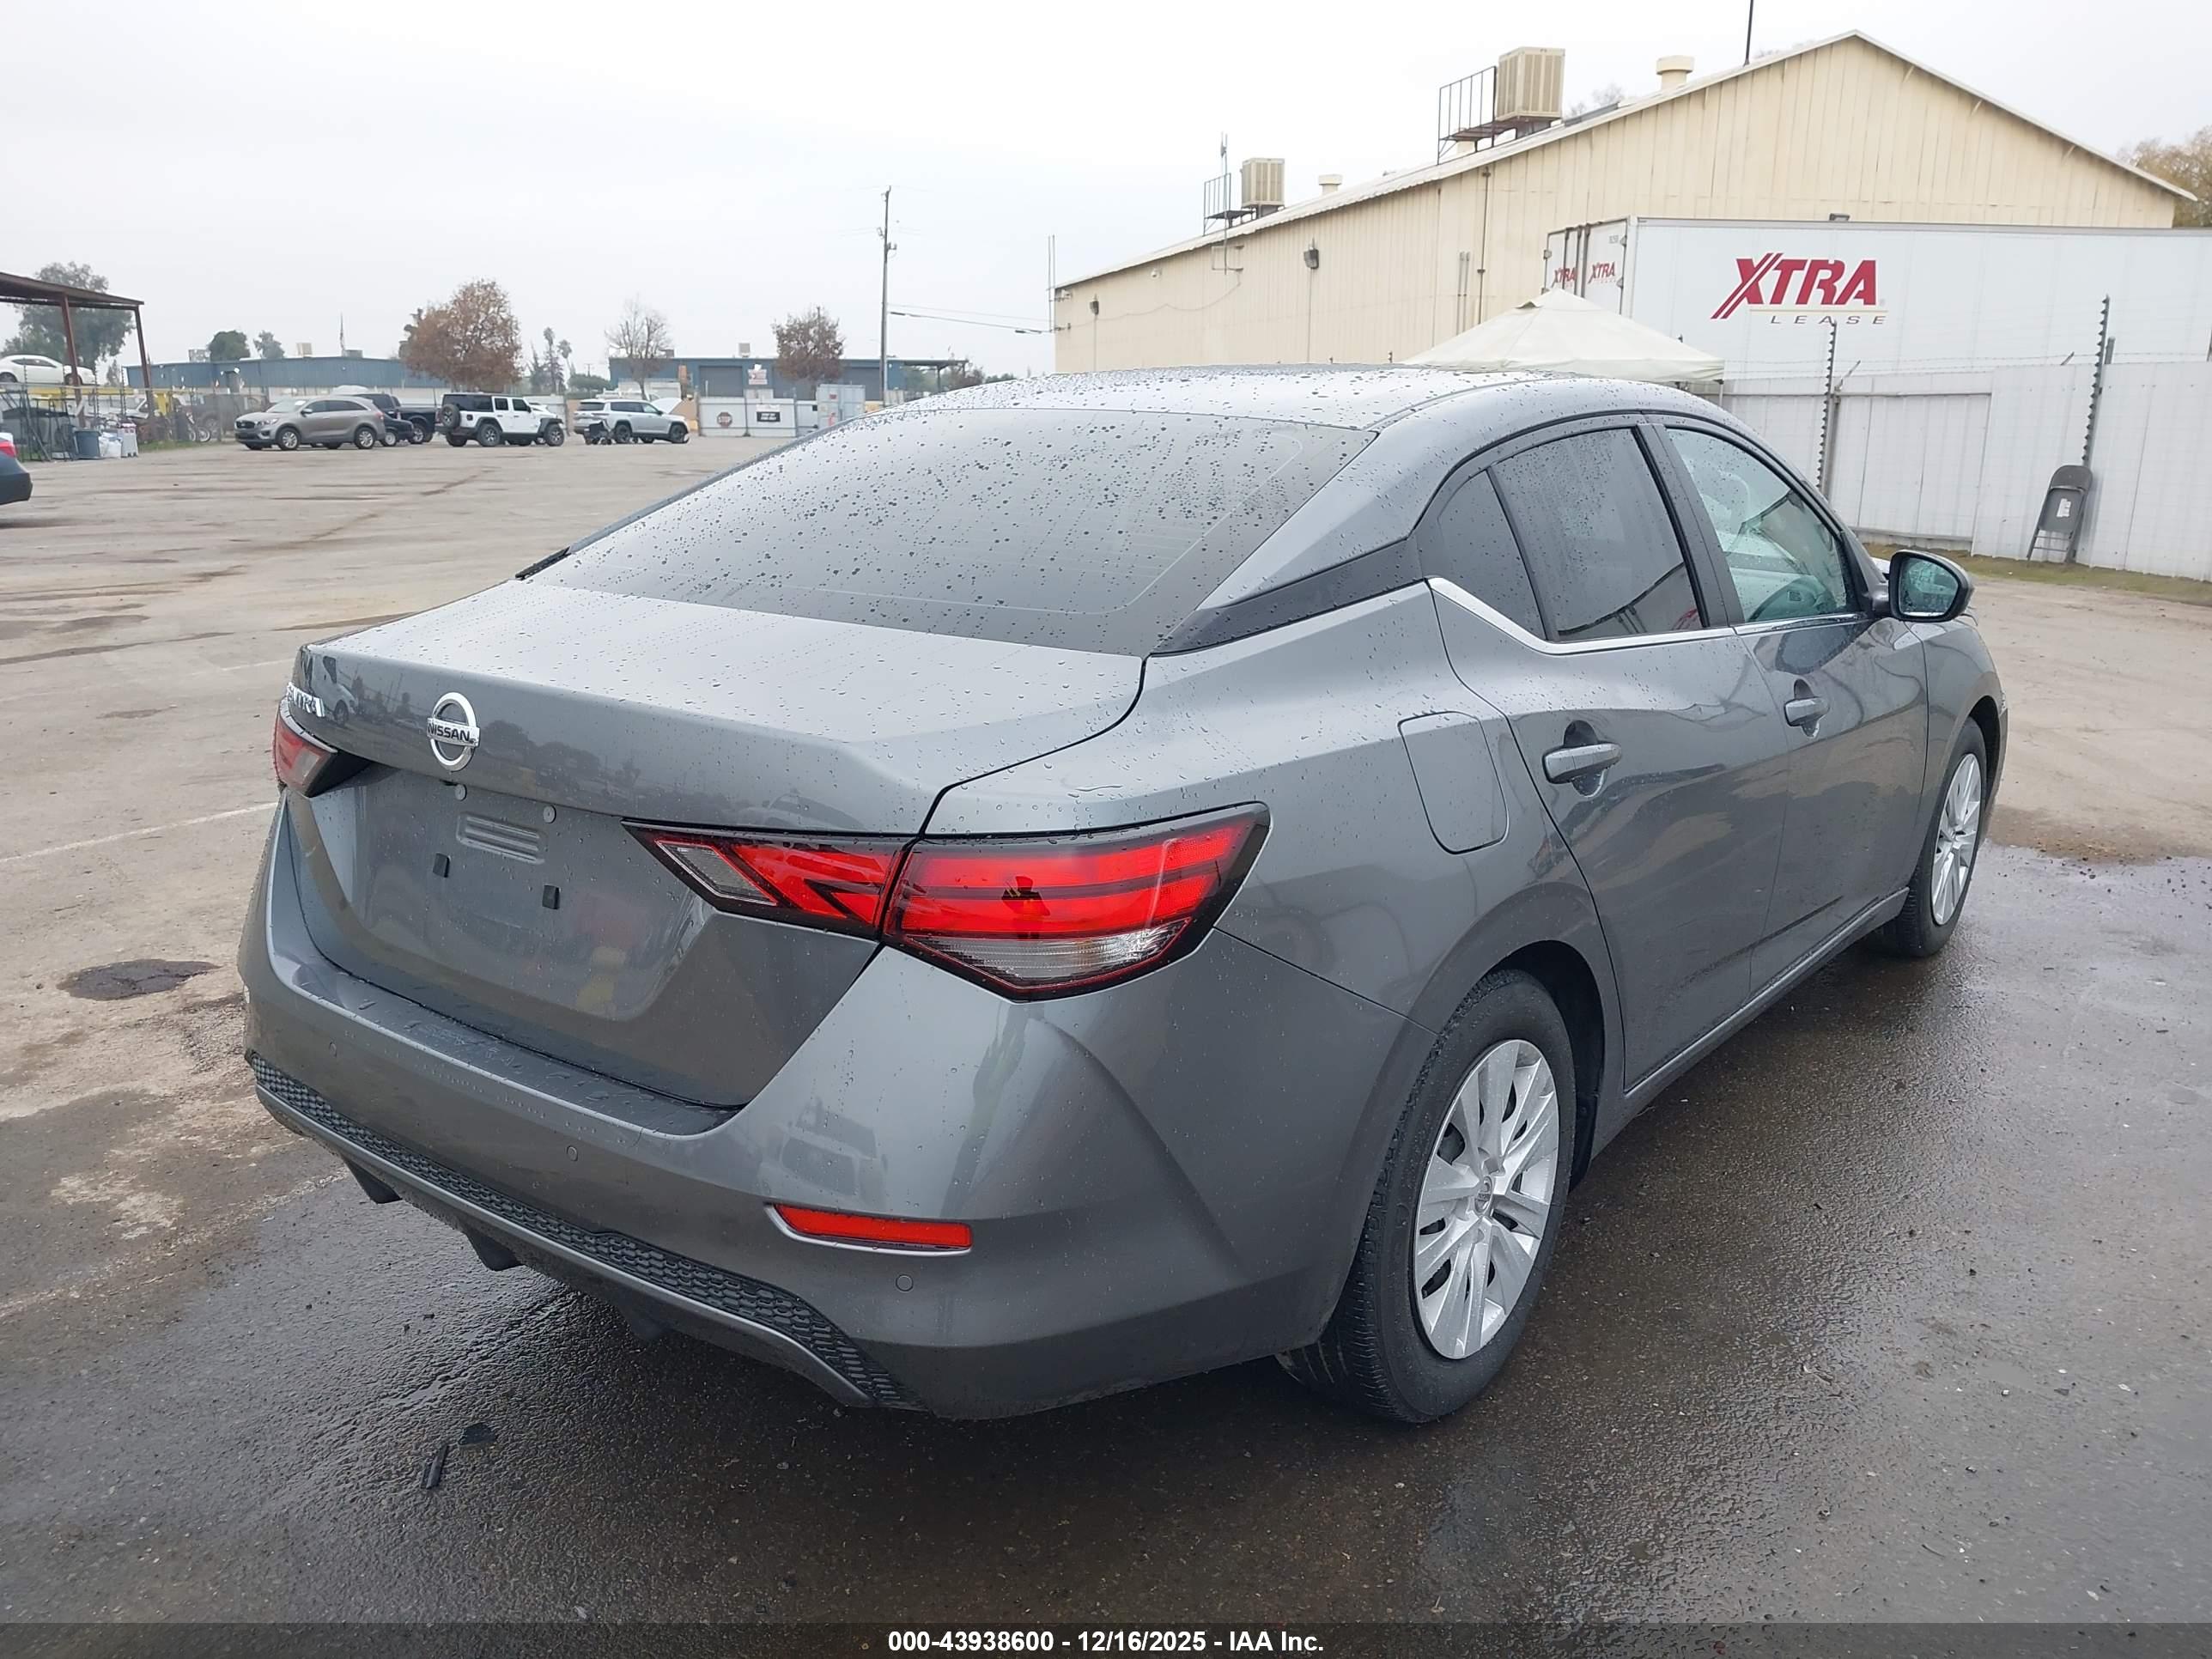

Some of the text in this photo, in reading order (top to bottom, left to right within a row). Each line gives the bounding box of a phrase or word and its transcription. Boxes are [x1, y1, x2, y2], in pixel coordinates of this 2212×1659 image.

[1589, 261, 1615, 284] XTRA
[1711, 252, 1876, 319] XTRA
[1770, 315, 1886, 325] LEASE
[428, 722, 471, 742] NISSAN
